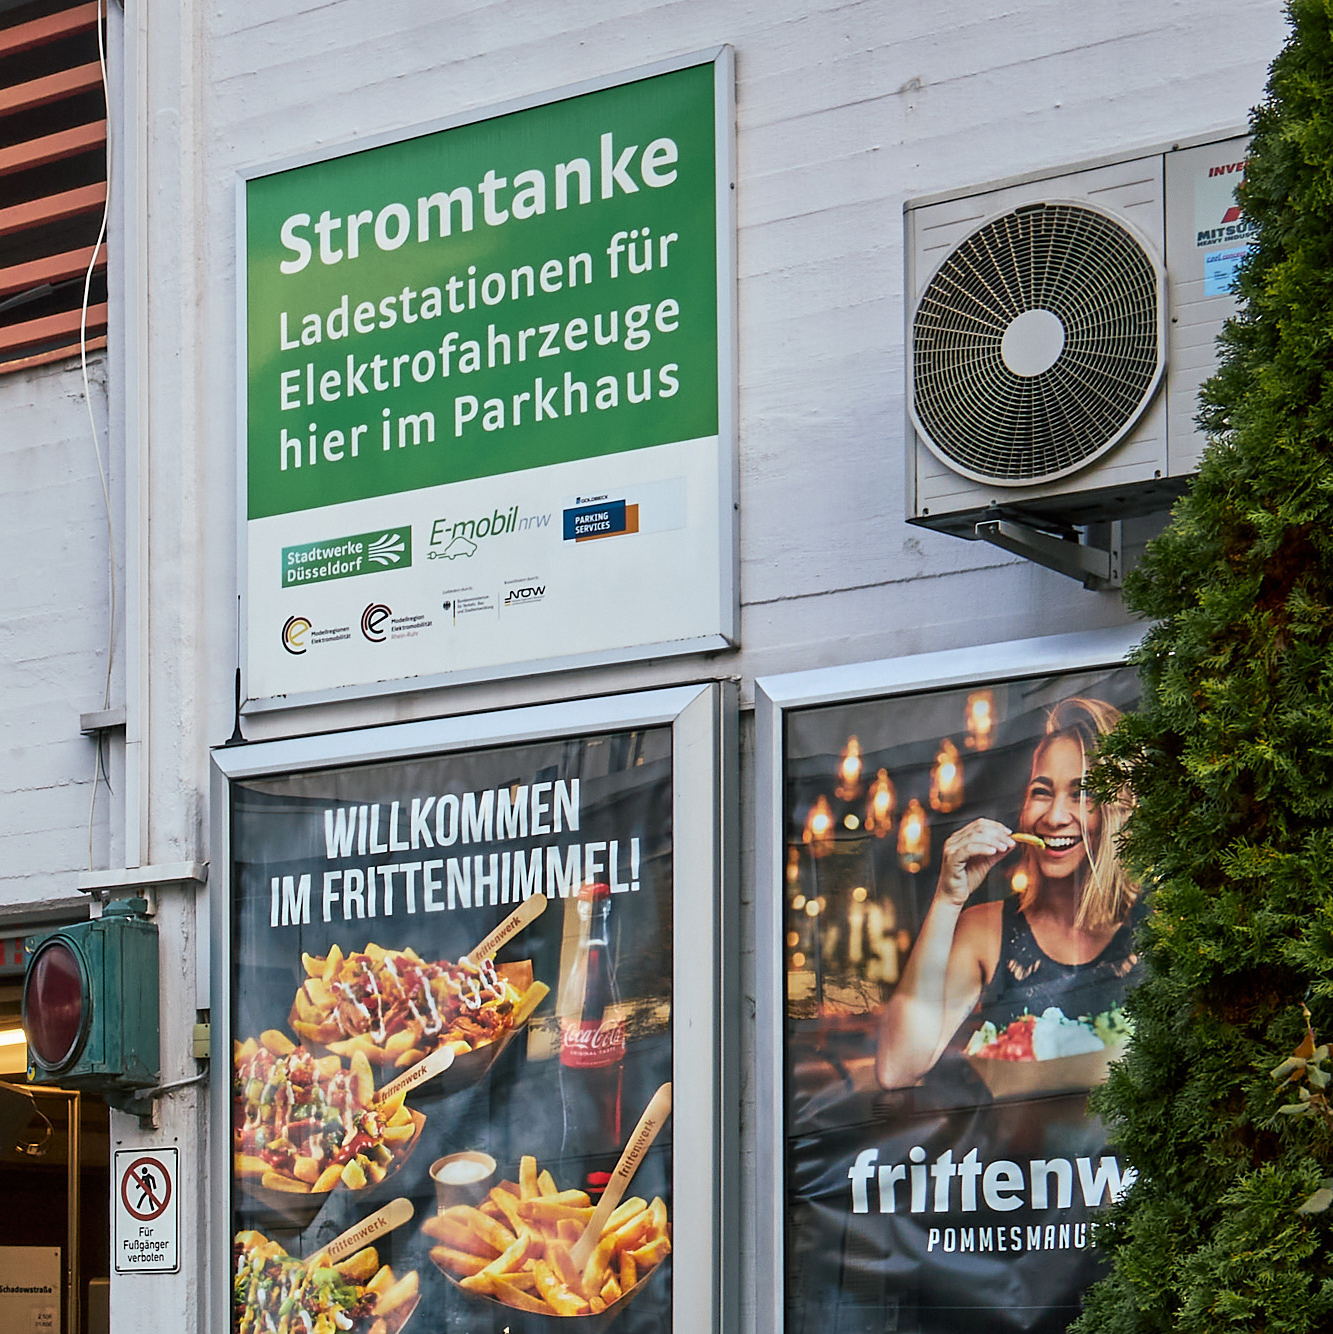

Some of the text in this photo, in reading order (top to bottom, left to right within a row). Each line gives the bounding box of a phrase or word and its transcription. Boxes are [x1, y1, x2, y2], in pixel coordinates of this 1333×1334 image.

[1208, 160, 1250, 178] INVE
[279, 131, 679, 275] Stromtanke
[279, 226, 679, 351] Ladestationen für
[279, 298, 681, 411] Elektrofahrzeuge
[279, 362, 680, 471] hier im Parkhaus
[575, 511, 609, 525] PARKING
[575, 520, 611, 534] SERVICES
[286, 540, 364, 567] Stadtwerke
[286, 557, 363, 583] Düsseldorf
[324, 778, 580, 859] WILLKOMMEN
[270, 837, 641, 927] IM FRITTENHIMMEL!
[475, 914, 521, 961] frittenwerk
[617, 1118, 657, 1179] frittenwerk
[848, 1146, 1139, 1214] frittenw
[123, 1239, 169, 1252] Fußgänger
[139, 1226, 154, 1237] Für
[326, 1216, 388, 1258] frittenwerk
[127, 1252, 164, 1263] verboten
